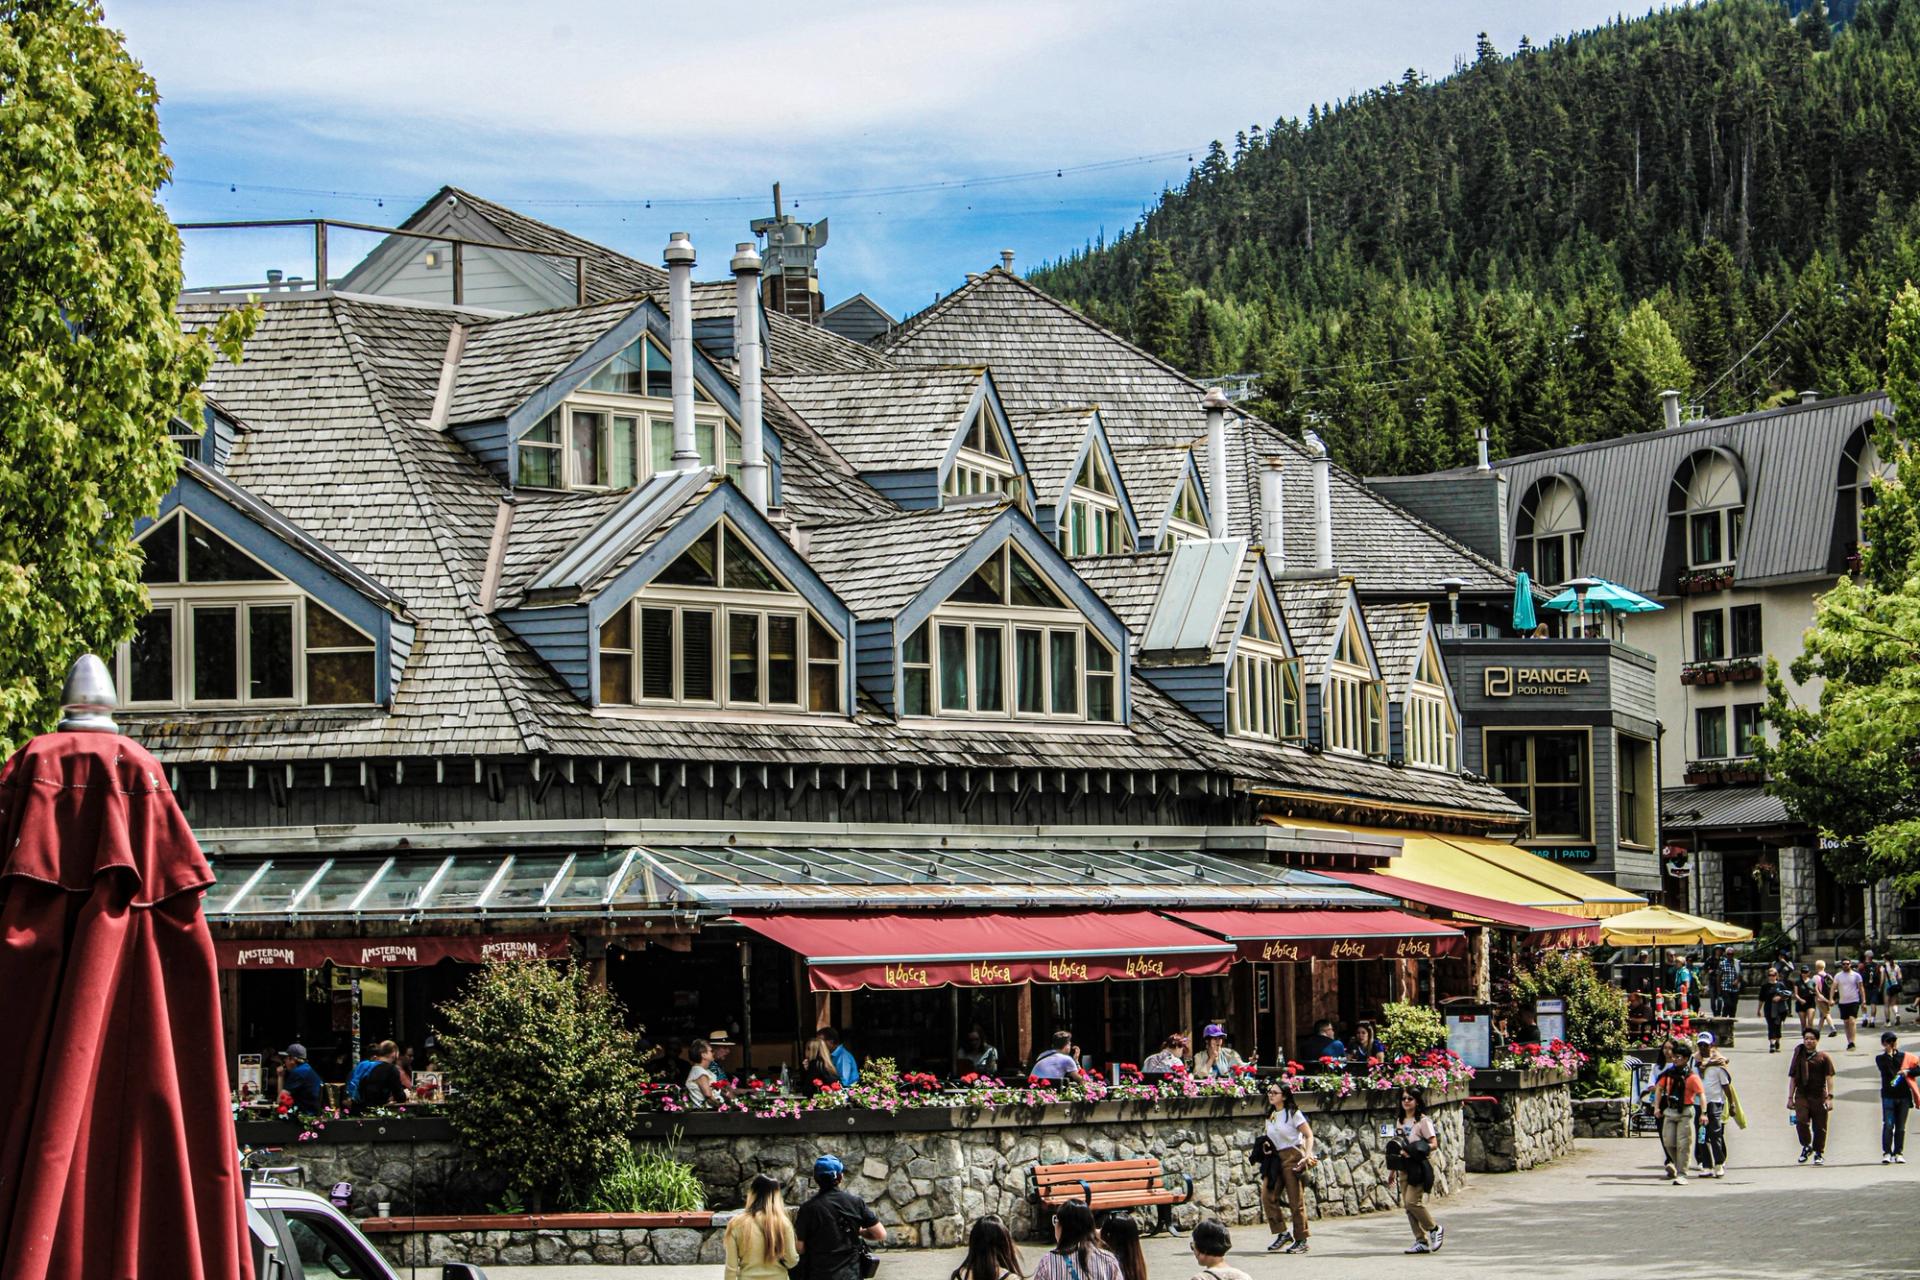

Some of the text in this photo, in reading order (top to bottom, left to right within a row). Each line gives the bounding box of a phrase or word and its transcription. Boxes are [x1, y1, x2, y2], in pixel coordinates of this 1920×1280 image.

[1517, 668, 1591, 683] PANGEA
[1517, 686, 1569, 695] POD HOTEL
[1562, 850, 1590, 859] PATIO
[361, 945, 418, 964] AMSTERDAM
[481, 942, 538, 959] AMSTERDAM
[237, 948, 295, 966] AMSTERDAM
[258, 956, 275, 965] PUB
[382, 954, 397, 963] PUB
